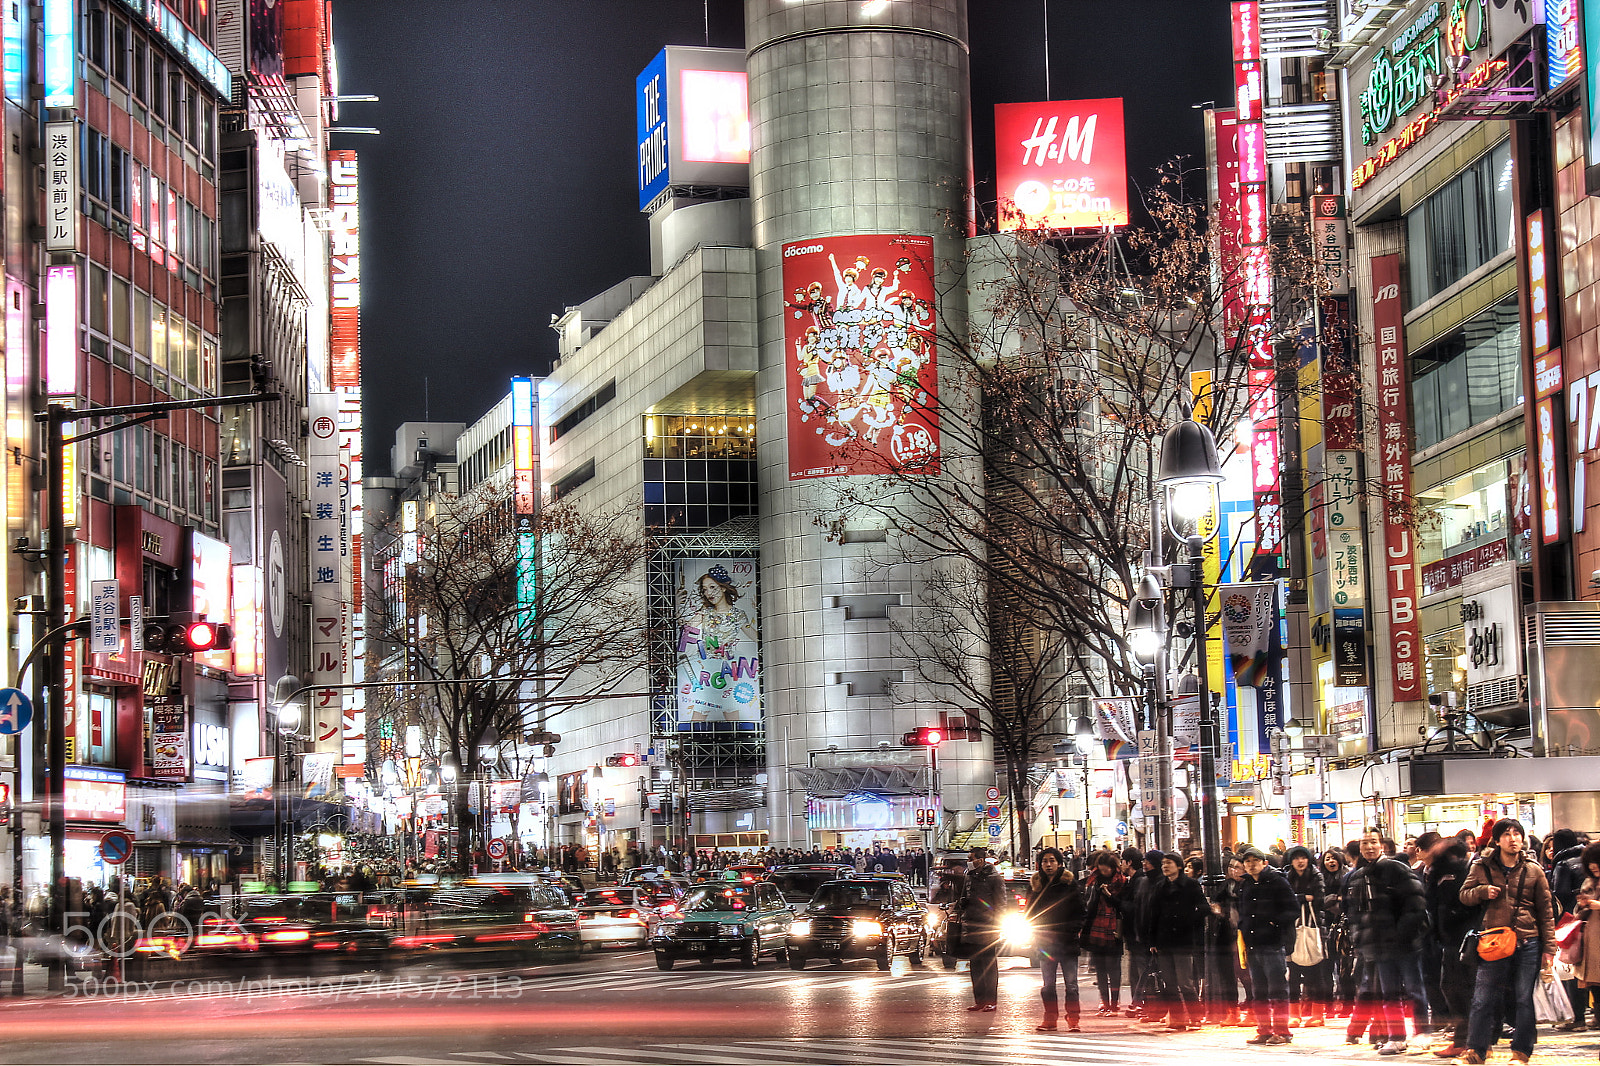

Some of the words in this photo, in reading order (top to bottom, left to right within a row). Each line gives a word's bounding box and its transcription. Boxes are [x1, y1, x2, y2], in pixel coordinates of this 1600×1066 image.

[1394, 28, 1441, 118] 西村
[643, 74, 660, 132] THE
[639, 121, 667, 191] PRIME
[1021, 113, 1098, 167] H&M
[51, 133, 68, 240] 渋谷駅前ビル
[1052, 175, 1095, 192] この先
[1052, 193, 1111, 215] 150m
[784, 244, 824, 258] docomo
[50, 269, 74, 279] 5F
[1375, 284, 1399, 303] JTB
[1327, 403, 1352, 421] JTB
[1331, 473, 1342, 511] パーラー
[1343, 467, 1354, 505] フルーツ
[316, 471, 335, 583] 洋装生地
[1332, 515, 1343, 524] 2F
[731, 563, 752, 577] 109
[1335, 551, 1346, 590] フルーツ
[1347, 545, 1358, 586] 渋谷西村
[103, 586, 116, 646] 渋谷駅前
[1336, 594, 1347, 602] 1F
[677, 624, 734, 660] FINAL
[316, 617, 338, 741] マルナン
[680, 656, 759, 695] BARGAIN
[154, 696, 168, 704] 2F
[154, 704, 184, 715] 喫茶室
[157, 715, 181, 724] エリヤ
